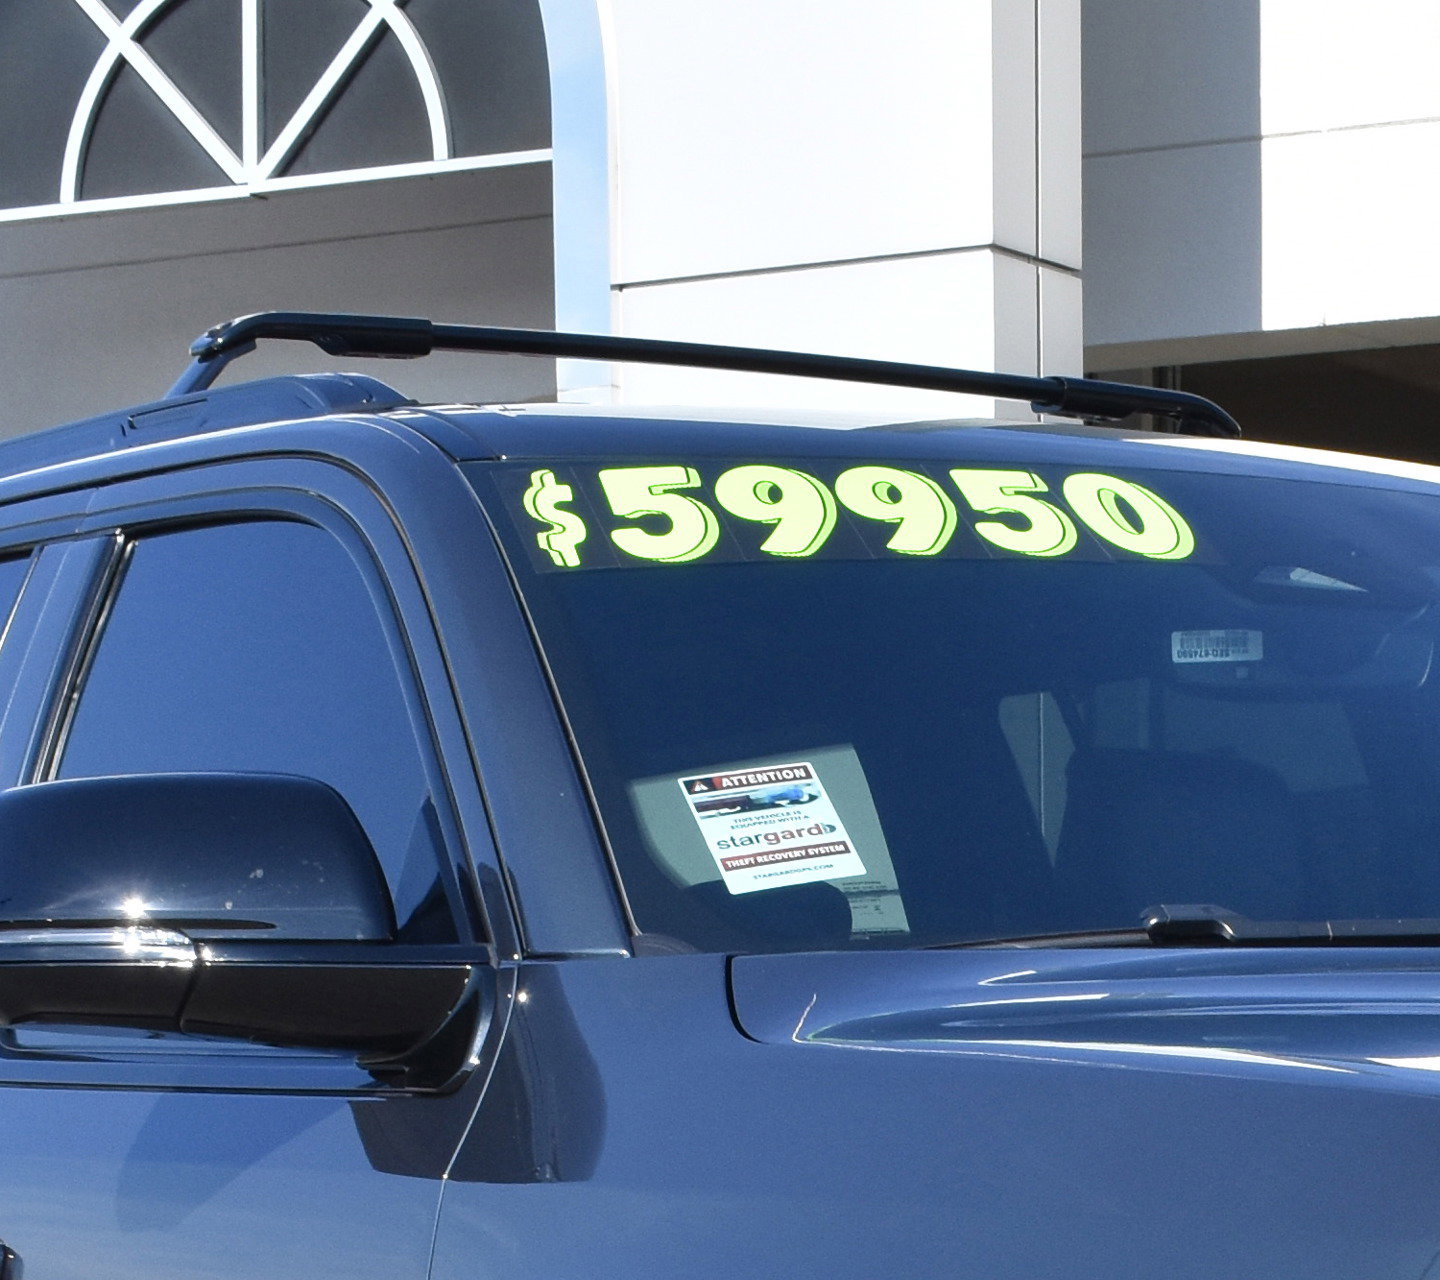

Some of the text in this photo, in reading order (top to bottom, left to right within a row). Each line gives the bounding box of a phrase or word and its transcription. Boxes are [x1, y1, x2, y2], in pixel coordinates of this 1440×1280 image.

[523, 465, 1194, 566] $59950
[721, 767, 806, 788] ATTENTION
[716, 823, 823, 850] stargard
[726, 844, 846, 869] THEFT RECOVERY SYSTEM
